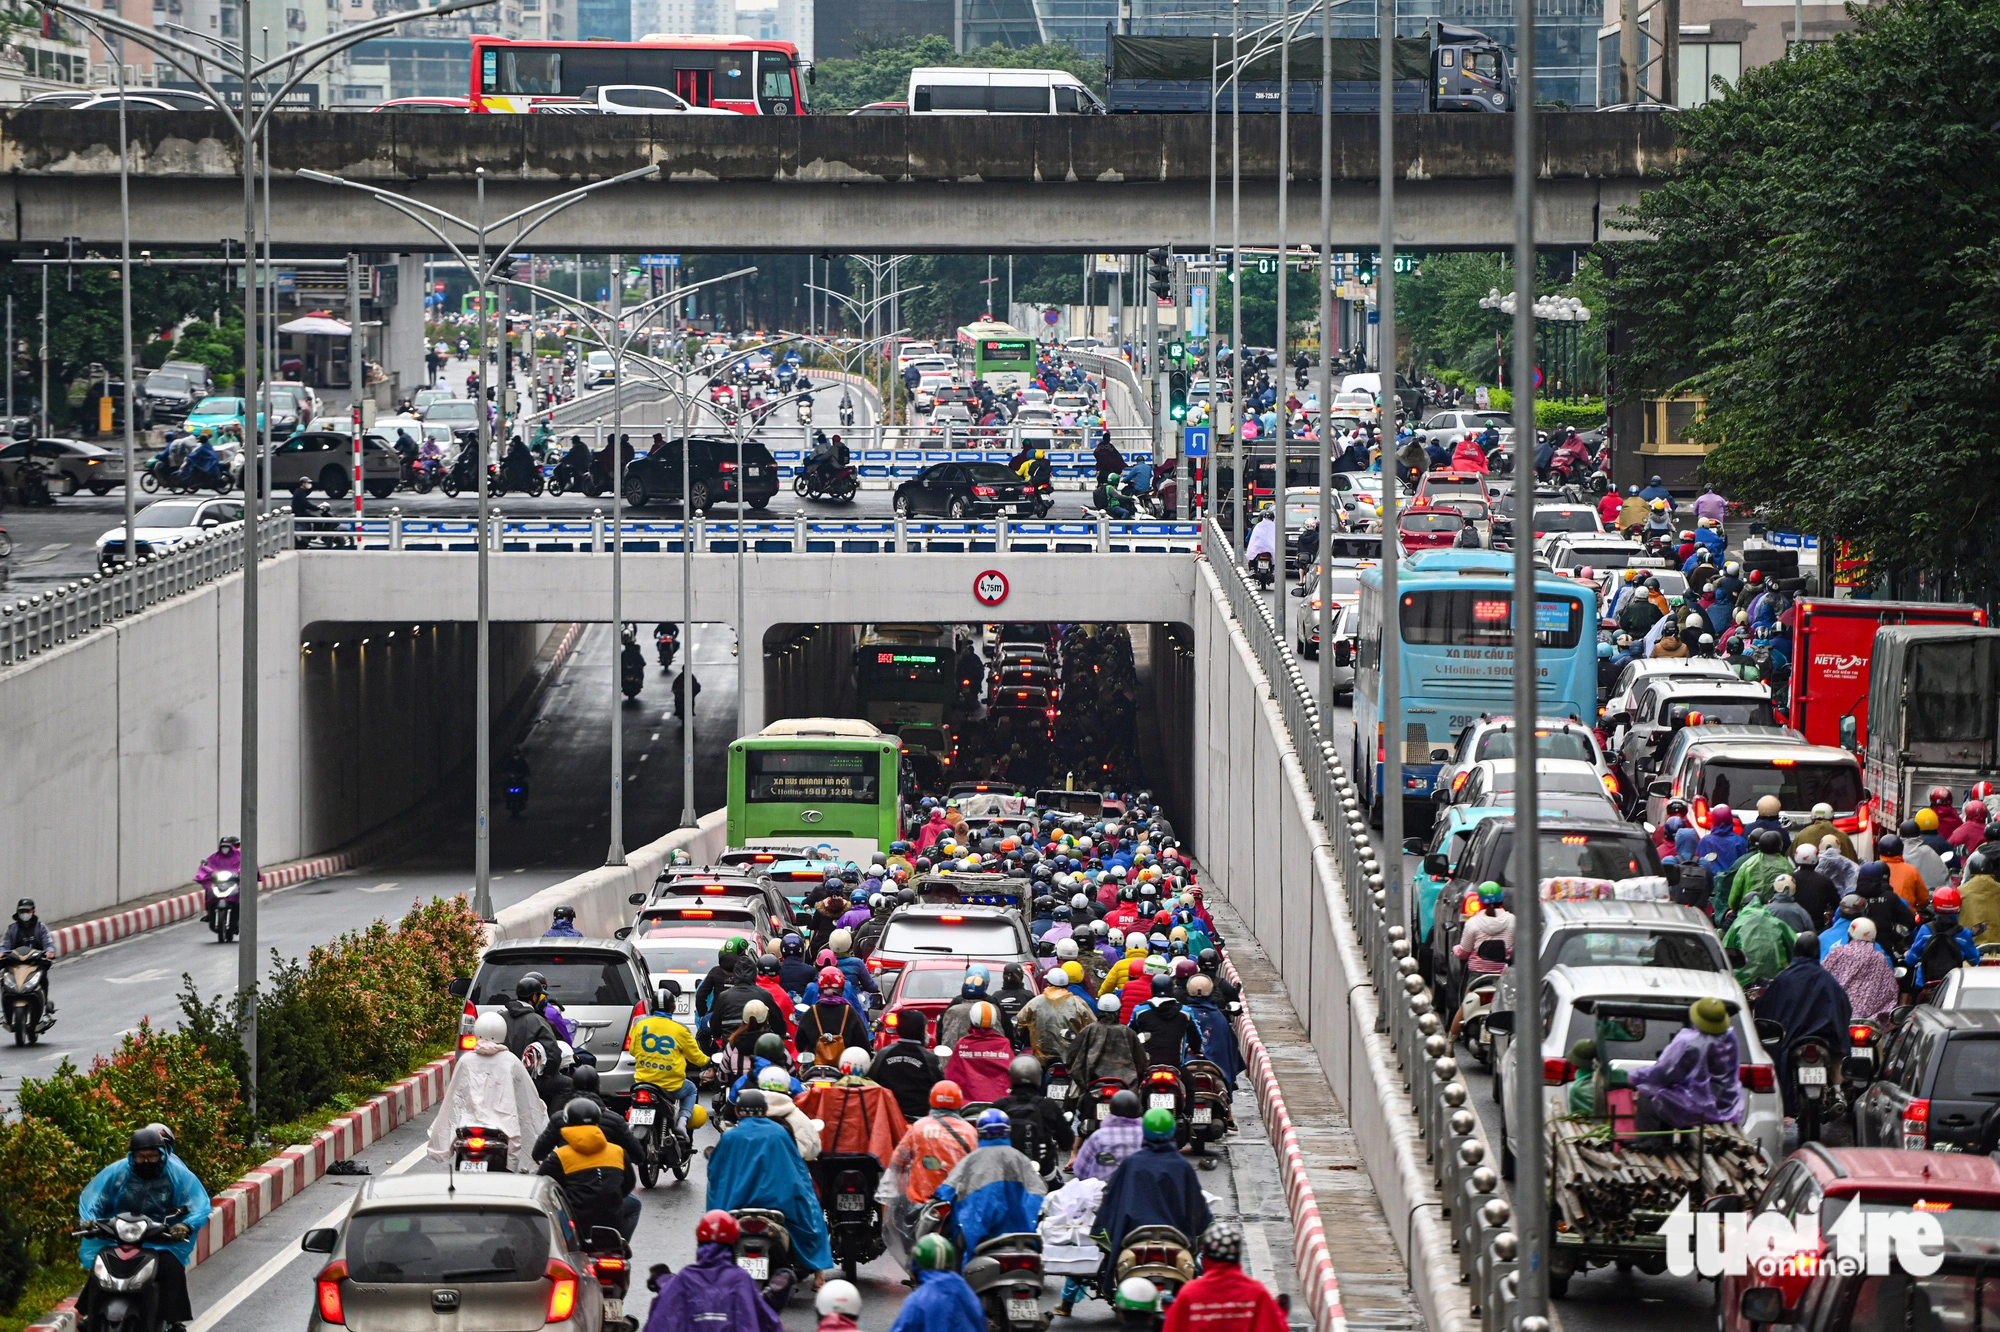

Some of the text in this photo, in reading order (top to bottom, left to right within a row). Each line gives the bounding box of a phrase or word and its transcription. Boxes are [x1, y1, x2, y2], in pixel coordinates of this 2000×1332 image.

[280, 92, 309, 102] OANH
[1259, 259, 1276, 273] 01
[1394, 258, 1411, 272] 01
[980, 580, 1002, 592] 4,75m
[1463, 649, 1482, 659] BUS
[804, 788, 827, 796] 1900
[831, 788, 853, 796] 1296
[641, 1026, 676, 1055] be
[437, 1294, 454, 1302] KIA
